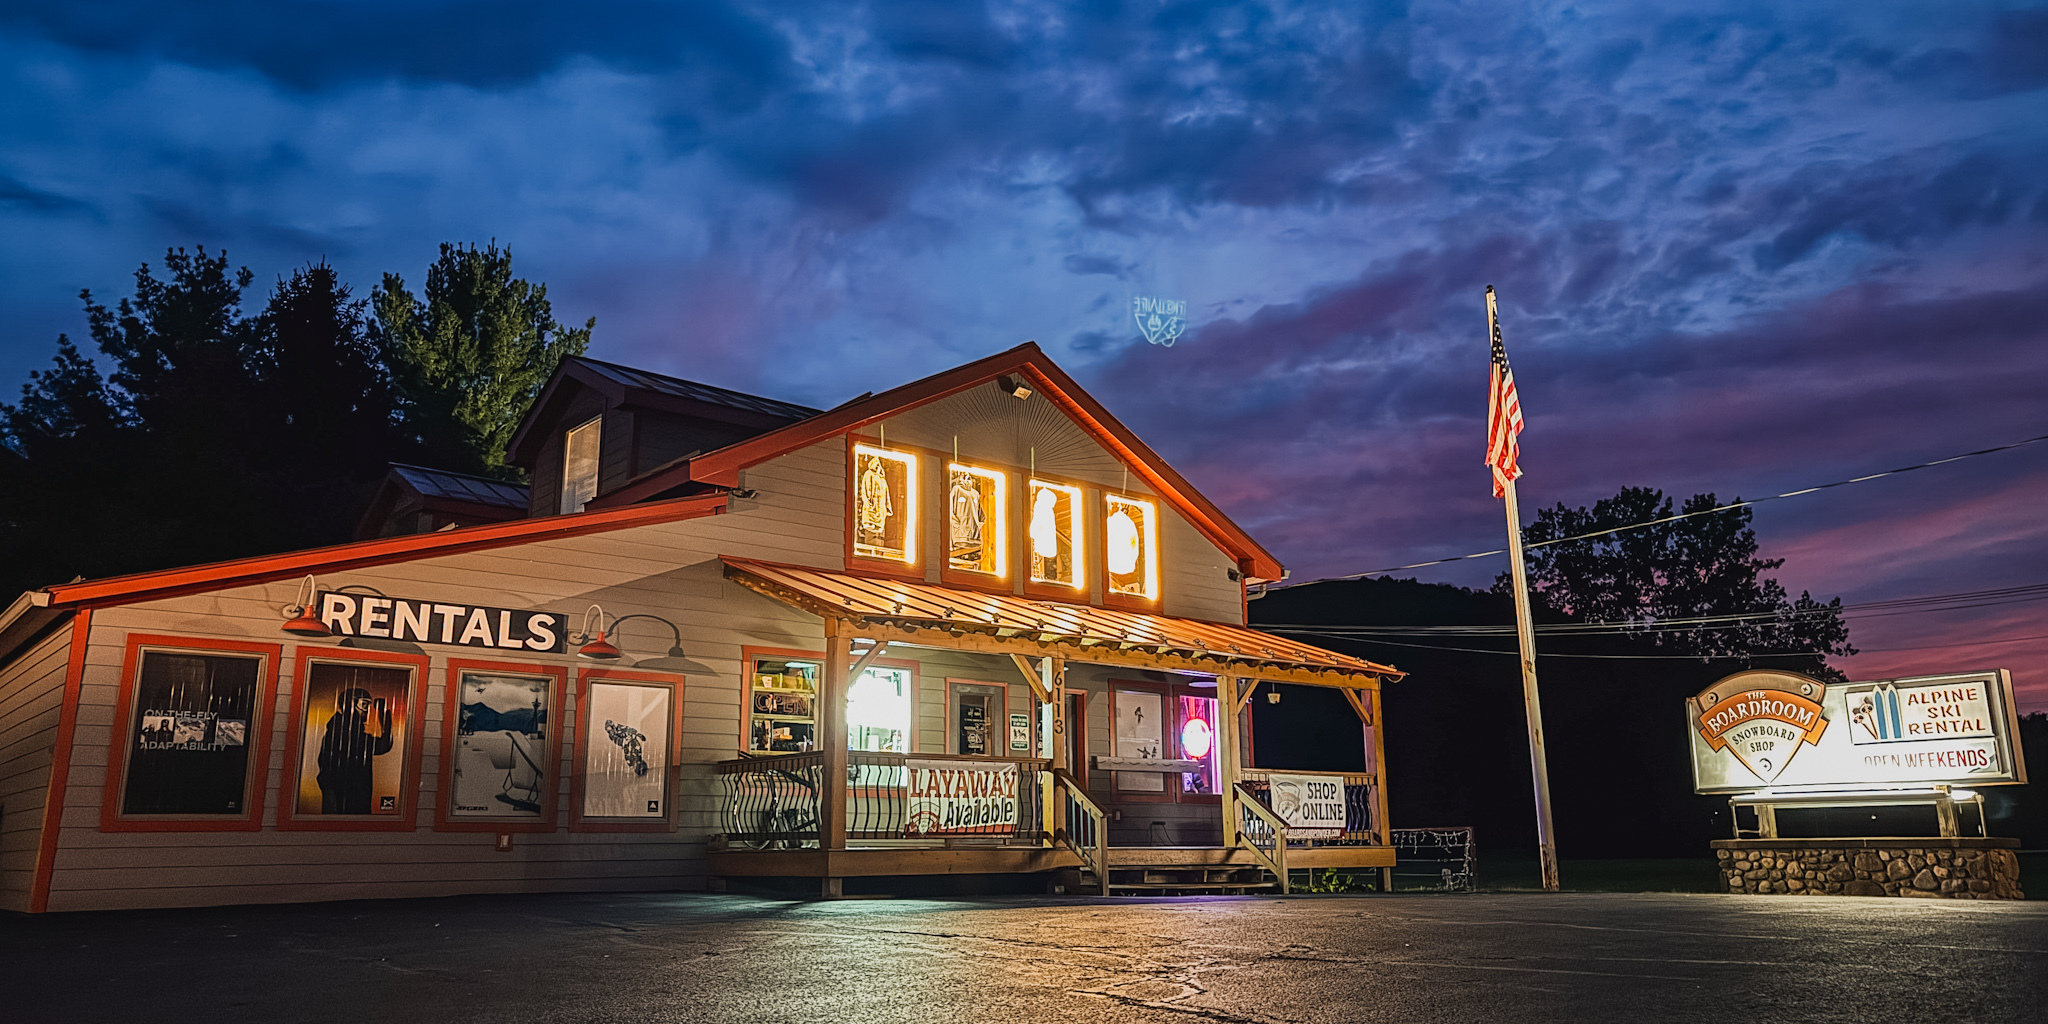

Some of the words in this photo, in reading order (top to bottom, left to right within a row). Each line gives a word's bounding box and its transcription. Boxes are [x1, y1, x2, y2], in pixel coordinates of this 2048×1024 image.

[322, 593, 556, 651] RENTALS
[755, 692, 809, 714] OPEN
[1054, 671, 1064, 735] 6113
[1745, 691, 1767, 701] THE
[1908, 688, 1978, 706] ALPINE
[144, 708, 218, 721] ON-THE-FLY
[1707, 700, 1814, 734] BOARDROOM
[1927, 704, 1962, 719] SKI
[1732, 725, 1795, 745] SNOWBOARD
[1908, 718, 1986, 735] RENTAL
[140, 741, 227, 752] ADAPTABILITY
[1750, 741, 1775, 752] SHOP
[1904, 749, 1988, 768] WEEKENDS
[910, 769, 1017, 799] LAYAWAY
[1307, 781, 1337, 800] SHOP
[943, 798, 1014, 828] Available
[1302, 802, 1343, 821] ONLINE
